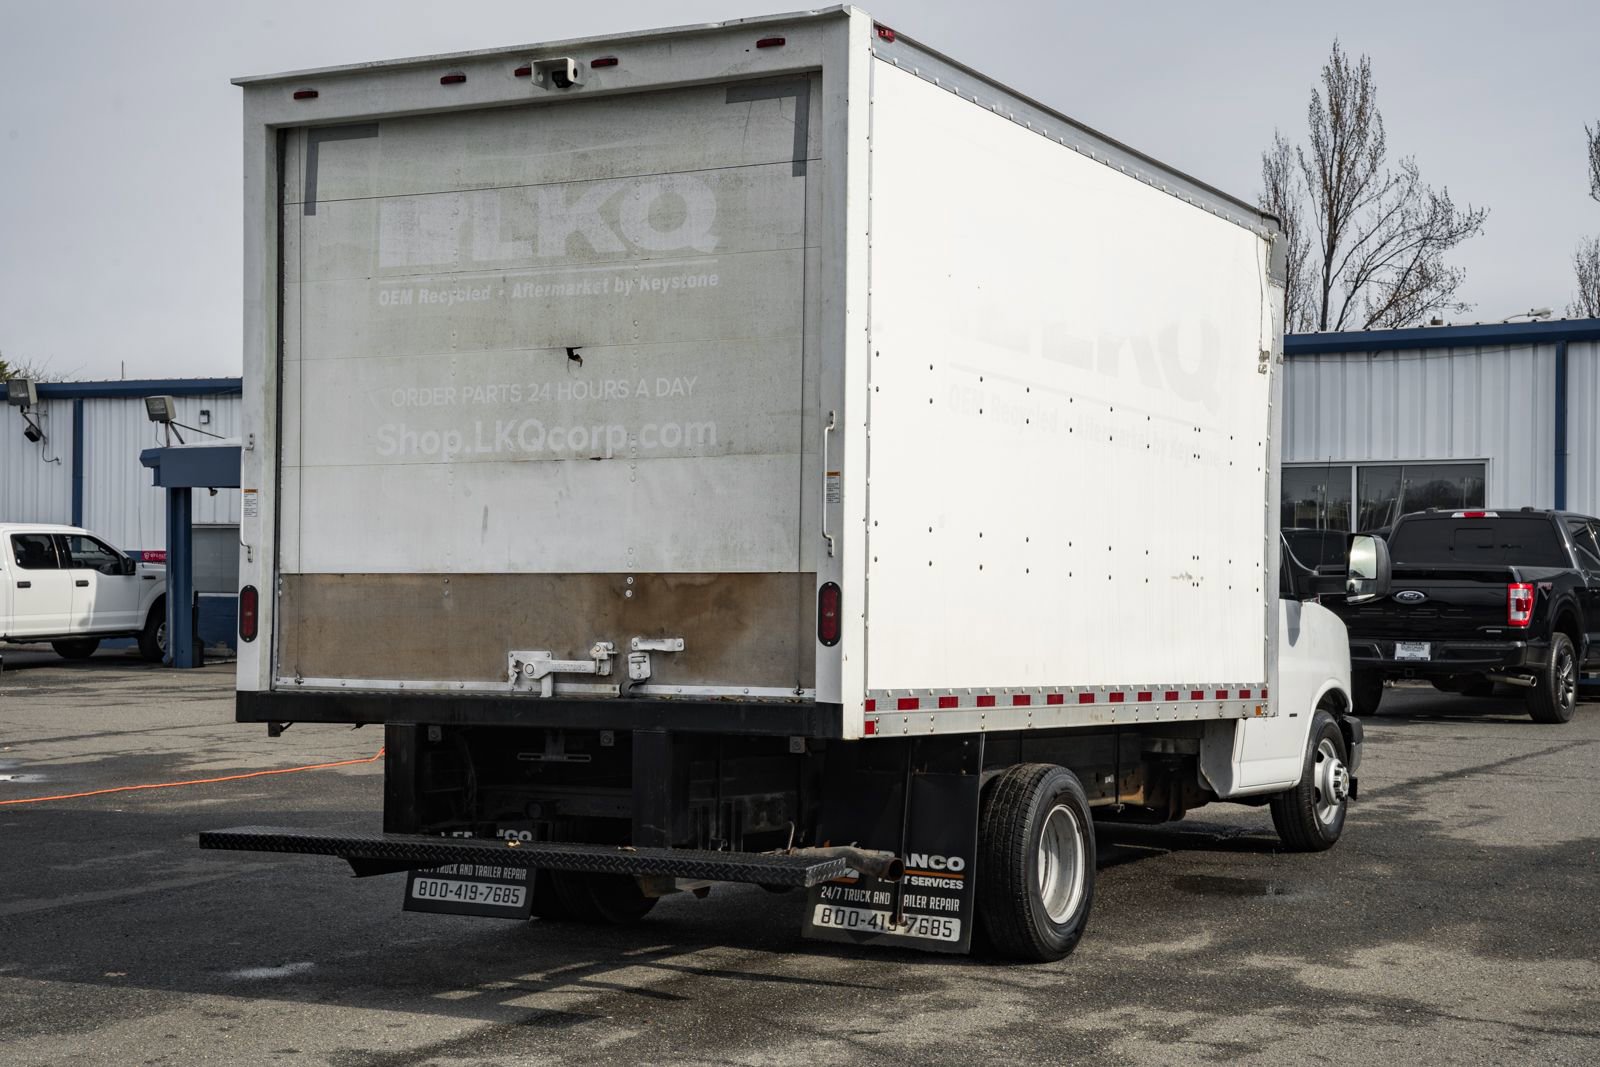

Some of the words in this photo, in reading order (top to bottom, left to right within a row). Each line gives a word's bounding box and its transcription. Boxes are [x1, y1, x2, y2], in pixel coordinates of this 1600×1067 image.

[378, 289, 413, 306] OEM
[419, 286, 491, 306] Recycled
[511, 276, 609, 298] Aftermarket
[614, 273, 634, 295] by
[639, 272, 719, 293] Keystone
[391, 386, 456, 407] ORDER
[462, 383, 522, 405] PARTS
[527, 383, 550, 402] 24
[557, 379, 629, 400] HOURS
[636, 378, 650, 397] A
[655, 376, 698, 397] DAY
[376, 418, 717, 462] Shop.LKQcorp.com
[459, 864, 473, 875] AND
[475, 865, 501, 878] TRAILER
[503, 868, 527, 880] REPAIR
[911, 876, 964, 889] SERVICES
[418, 881, 520, 904] 800-419-7685
[820, 885, 842, 900] 24/7
[844, 888, 871, 903] TRUCK
[873, 891, 891, 905] AND
[903, 893, 927, 908] AILER
[929, 896, 960, 912] REPAIR
[821, 908, 953, 937] 800-417685
